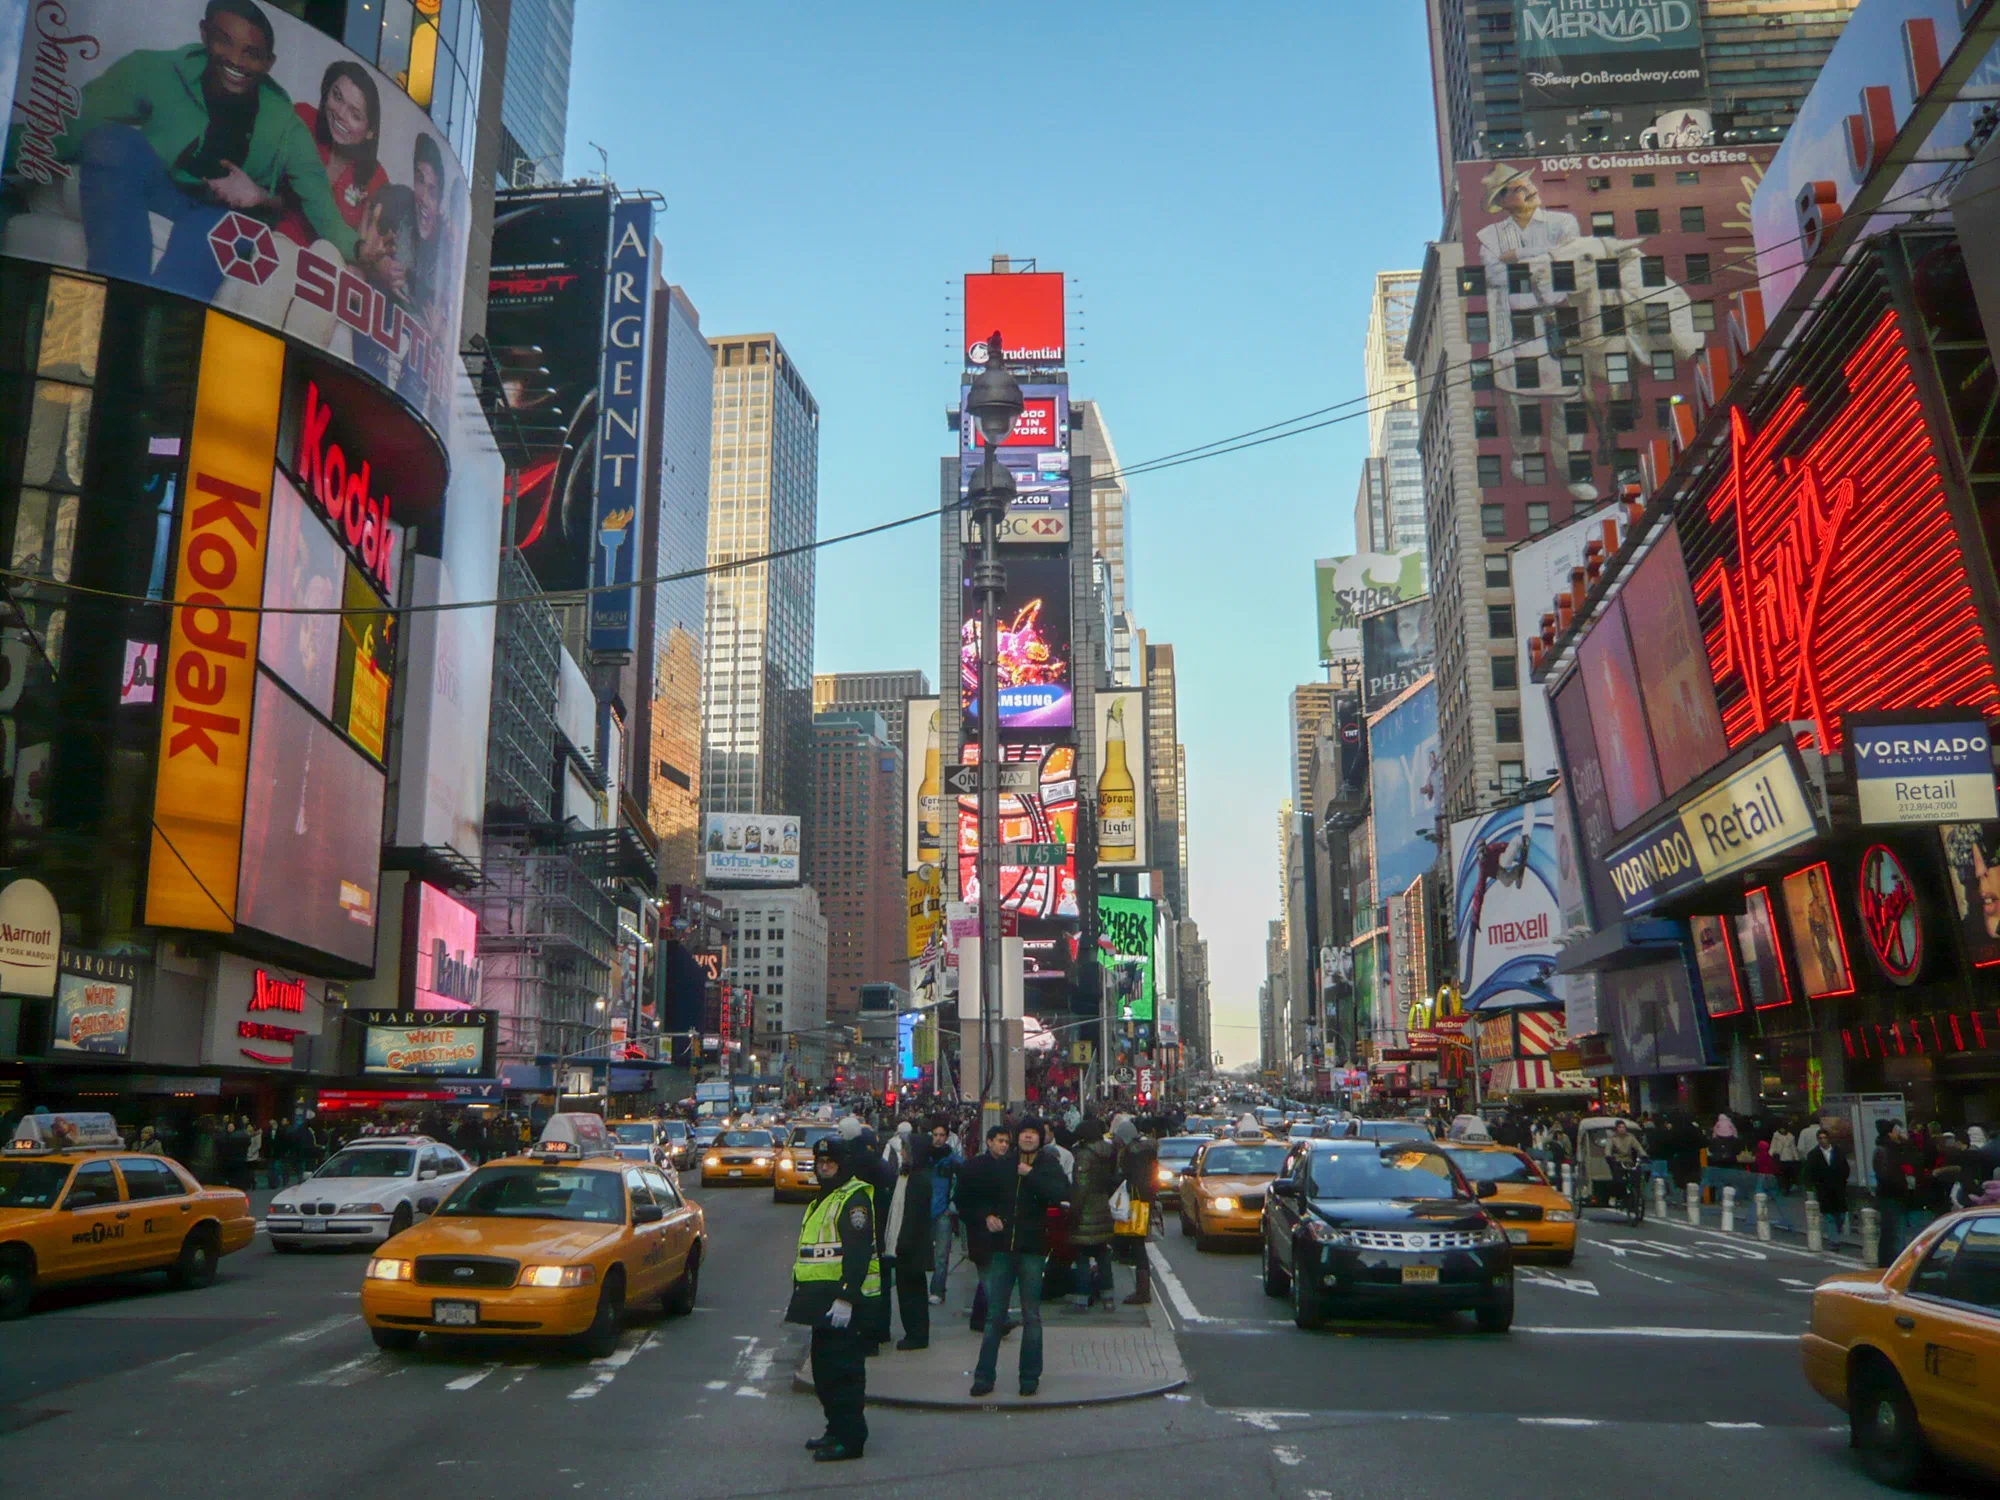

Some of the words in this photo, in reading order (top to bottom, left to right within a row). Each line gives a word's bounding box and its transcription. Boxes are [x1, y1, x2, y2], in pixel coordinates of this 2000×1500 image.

[1522, 2, 1692, 42] MERMAID
[1541, 158, 1583, 172] 100%
[1588, 153, 1682, 170] Colombian
[1687, 150, 1747, 165] Coffee
[602, 221, 647, 487] ARGENT
[1000, 347, 1062, 360] rudential
[300, 380, 397, 595] Kodak
[1334, 586, 1402, 617] SHREK
[169, 472, 261, 767] Kodak
[1370, 664, 1433, 697] PHAN
[1000, 693, 1053, 707] MSUNG
[1854, 736, 1988, 759] VORNADO
[1878, 756, 1923, 764] REALTY
[1928, 754, 1968, 762] TRUST
[958, 774, 977, 786] ON
[1895, 779, 1956, 801] Retail
[921, 795, 940, 807] Cor
[1899, 801, 1958, 812] 212.894.7000
[1103, 819, 1132, 835] Light
[1701, 776, 1784, 857] Retail
[711, 852, 752, 868] HOTEL
[760, 855, 796, 869] DOGS
[1020, 846, 1030, 863] W
[1034, 846, 1050, 863] 45
[1054, 847, 1064, 856] ST
[1609, 831, 1693, 904] VORNADO
[0, 923, 51, 946] Marriott
[1488, 912, 1548, 946] maxell
[61, 950, 135, 980] MARQUIS
[84, 982, 117, 1007] WHITE
[70, 1008, 127, 1045] CHRISTMAS
[368, 1012, 487, 1024] MARQUIS
[1436, 1021, 1464, 1029] McDon
[405, 1028, 456, 1045] WHITE
[387, 1043, 477, 1070] CHRISTMAS
[1141, 1068, 1152, 1093] tkts
